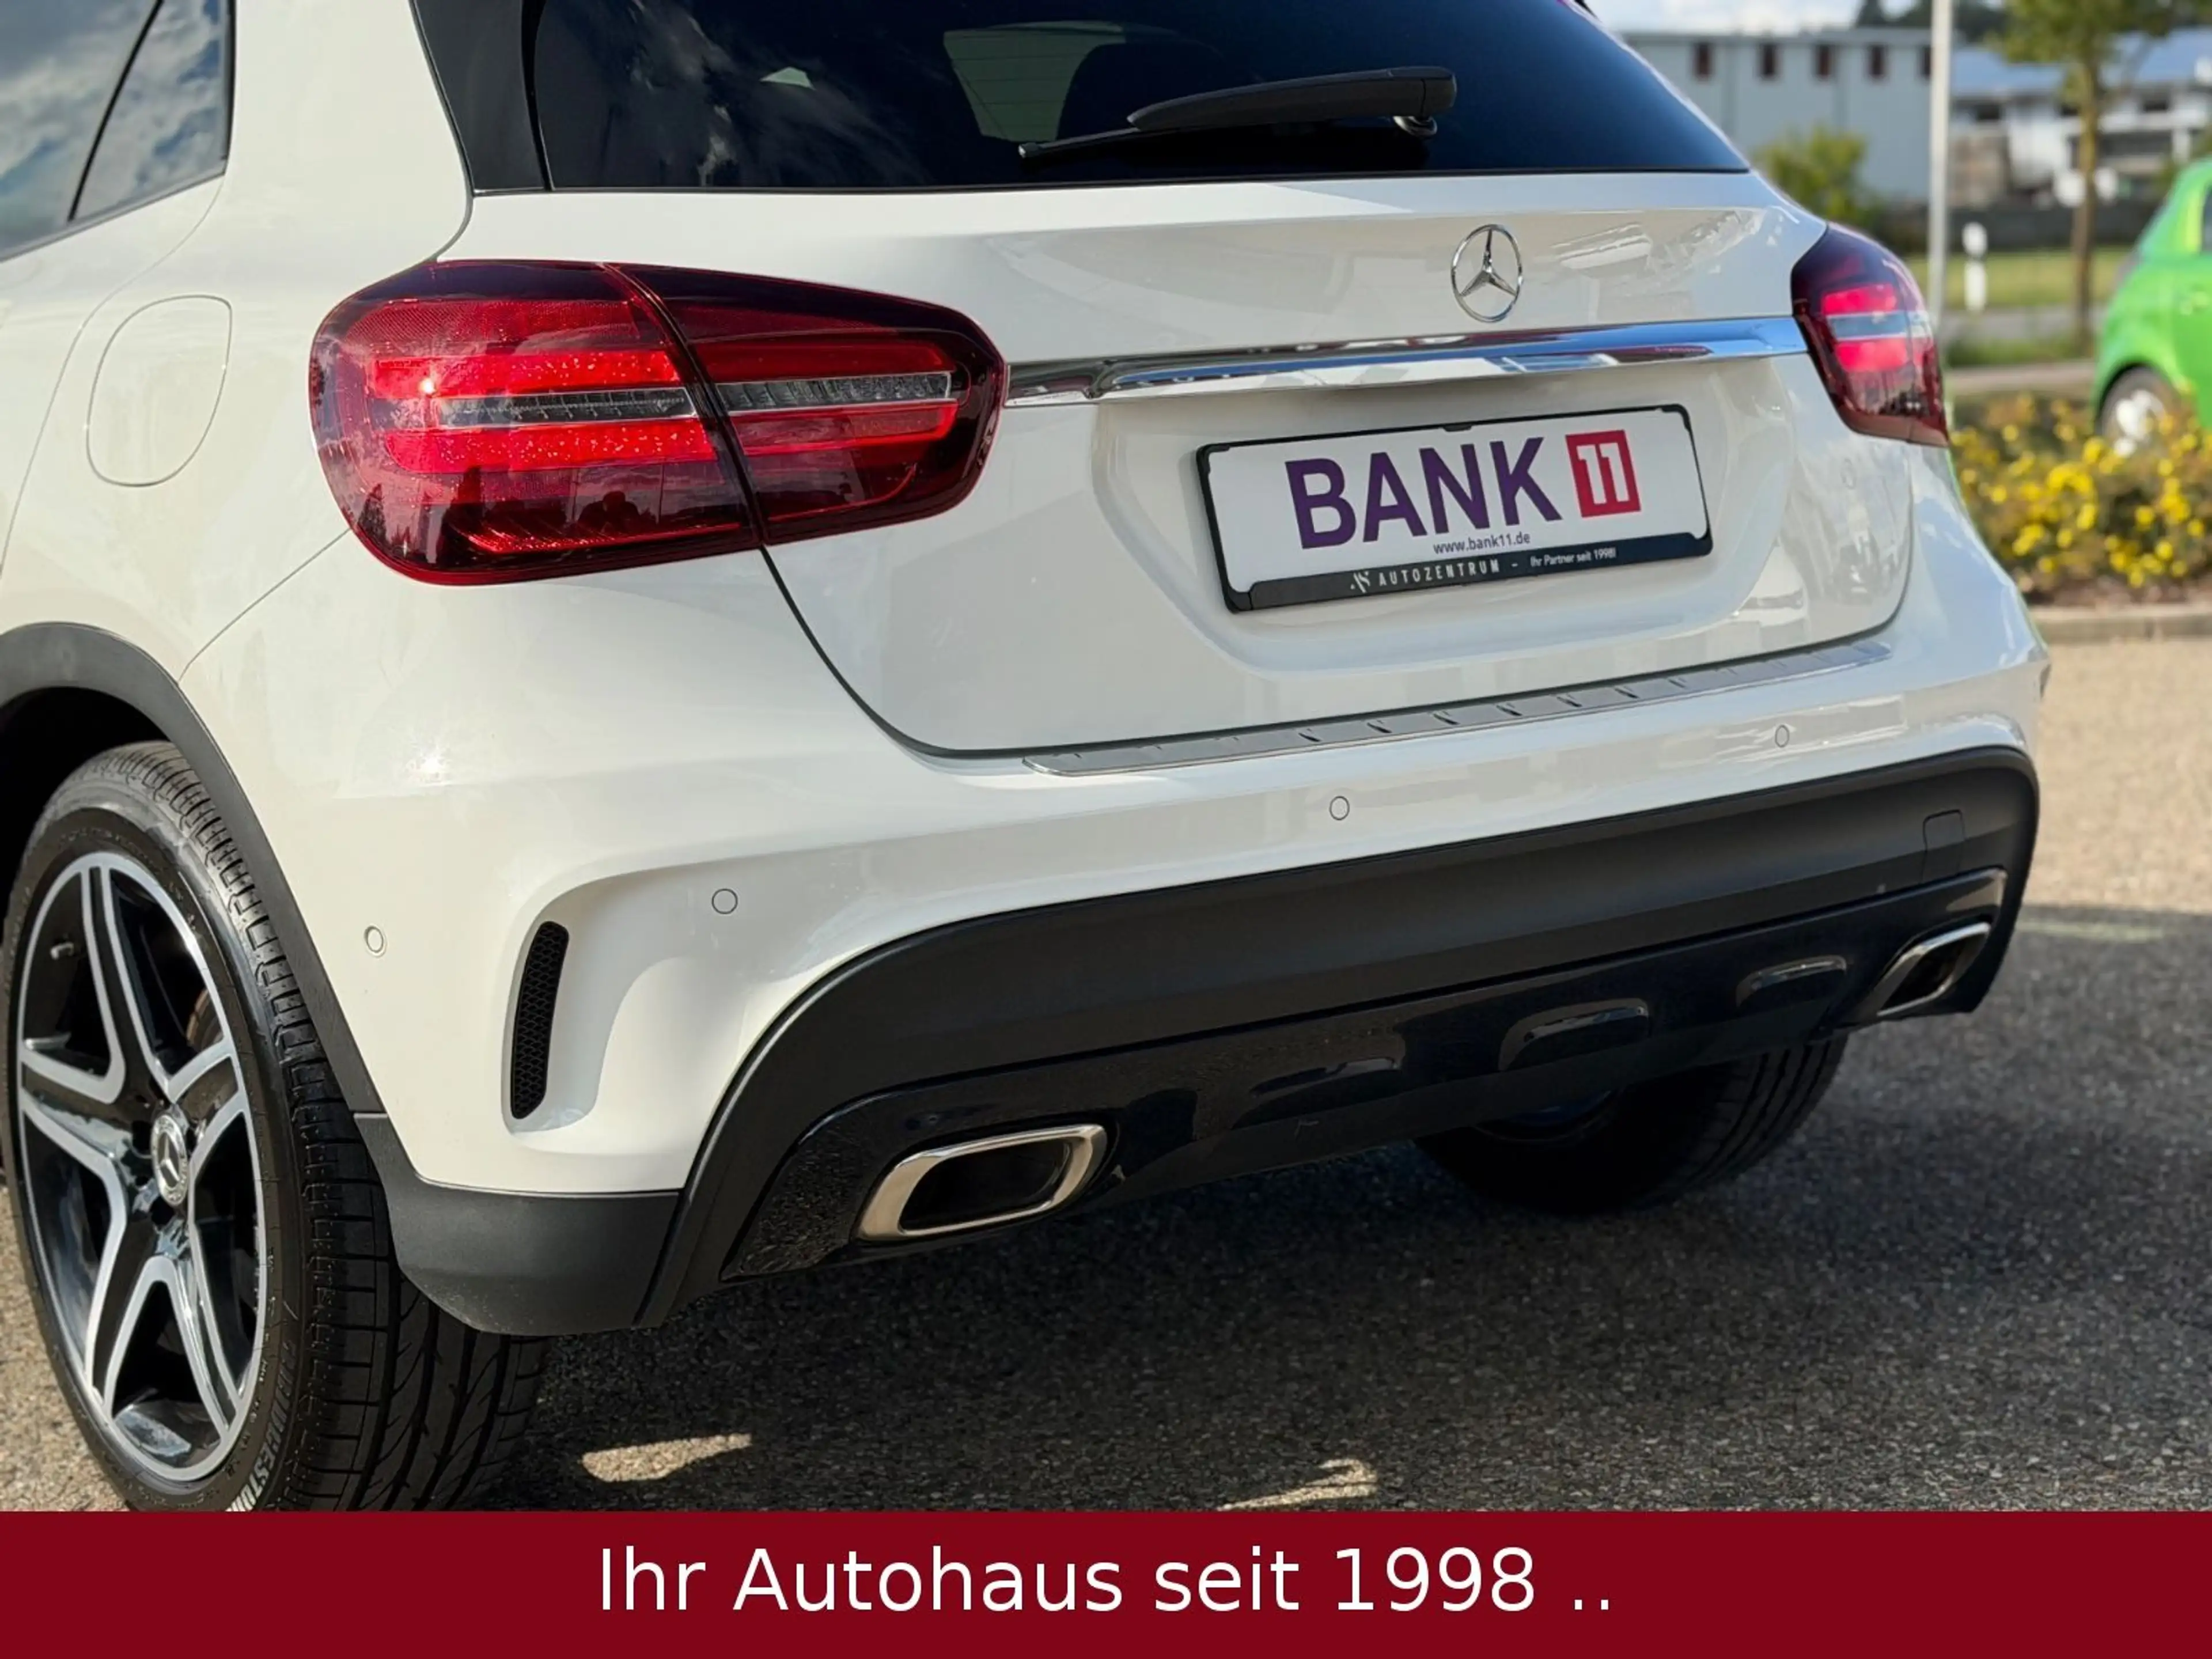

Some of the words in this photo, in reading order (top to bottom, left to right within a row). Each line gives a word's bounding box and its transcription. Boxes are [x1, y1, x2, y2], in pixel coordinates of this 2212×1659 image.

[1285, 437, 1563, 550] BANK
[1576, 442, 1630, 505] 11
[1379, 559, 1499, 587] AUTOZENTRUM
[1531, 556, 1542, 567] Ihr
[1544, 553, 1574, 566] Partner
[1576, 551, 1592, 563] seit
[1433, 531, 1531, 554] www.bank11.de
[226, 1339, 298, 1512] BRIDGESTON
